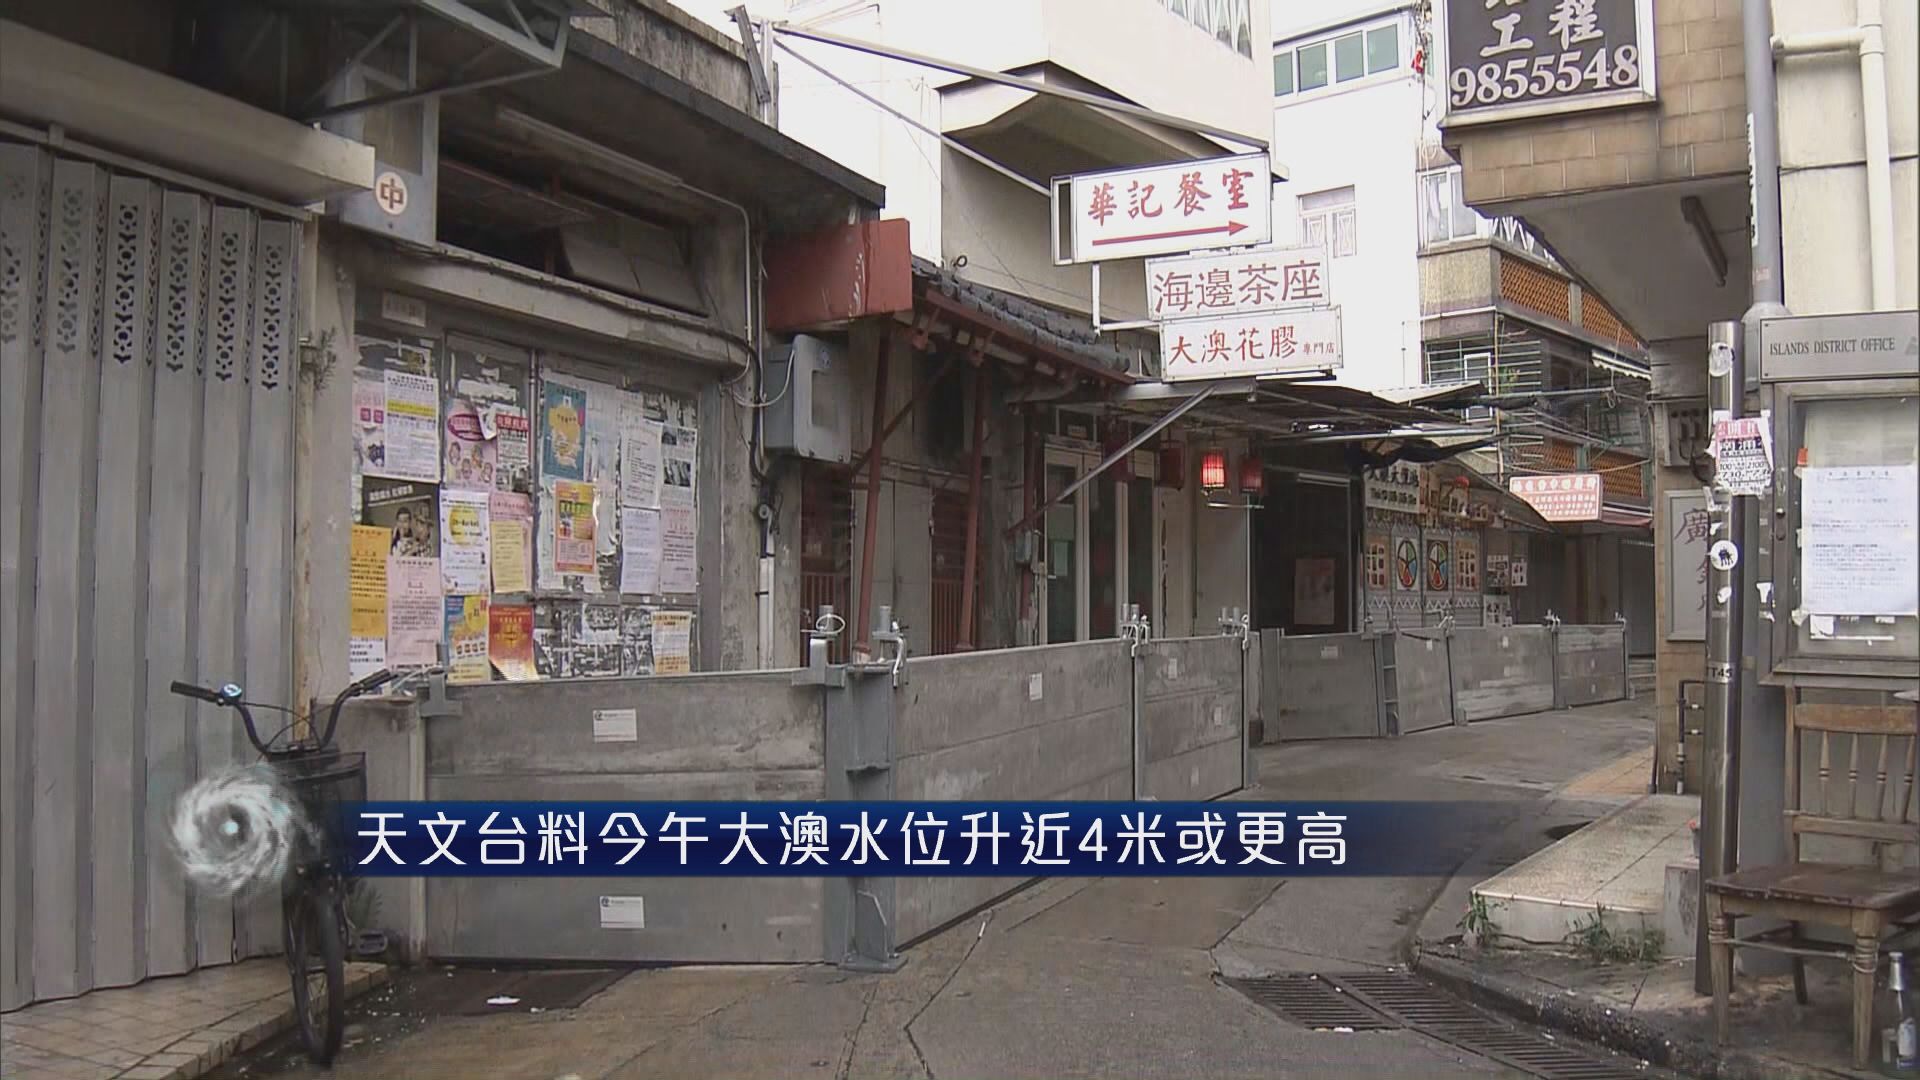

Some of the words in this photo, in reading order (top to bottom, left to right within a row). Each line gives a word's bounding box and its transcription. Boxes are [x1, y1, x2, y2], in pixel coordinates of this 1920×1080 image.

[1449, 44, 1638, 107] 9855548
[1087, 167, 1255, 226] 華記餐室
[1153, 260, 1324, 313] 海邊茶座
[1168, 325, 1299, 366] 大澳花膠
[1302, 341, 1335, 356] 專門店
[1769, 341, 1809, 356] ISLANDS
[1813, 339, 1857, 354] DISTRICT
[1860, 337, 1896, 352] OFFICE
